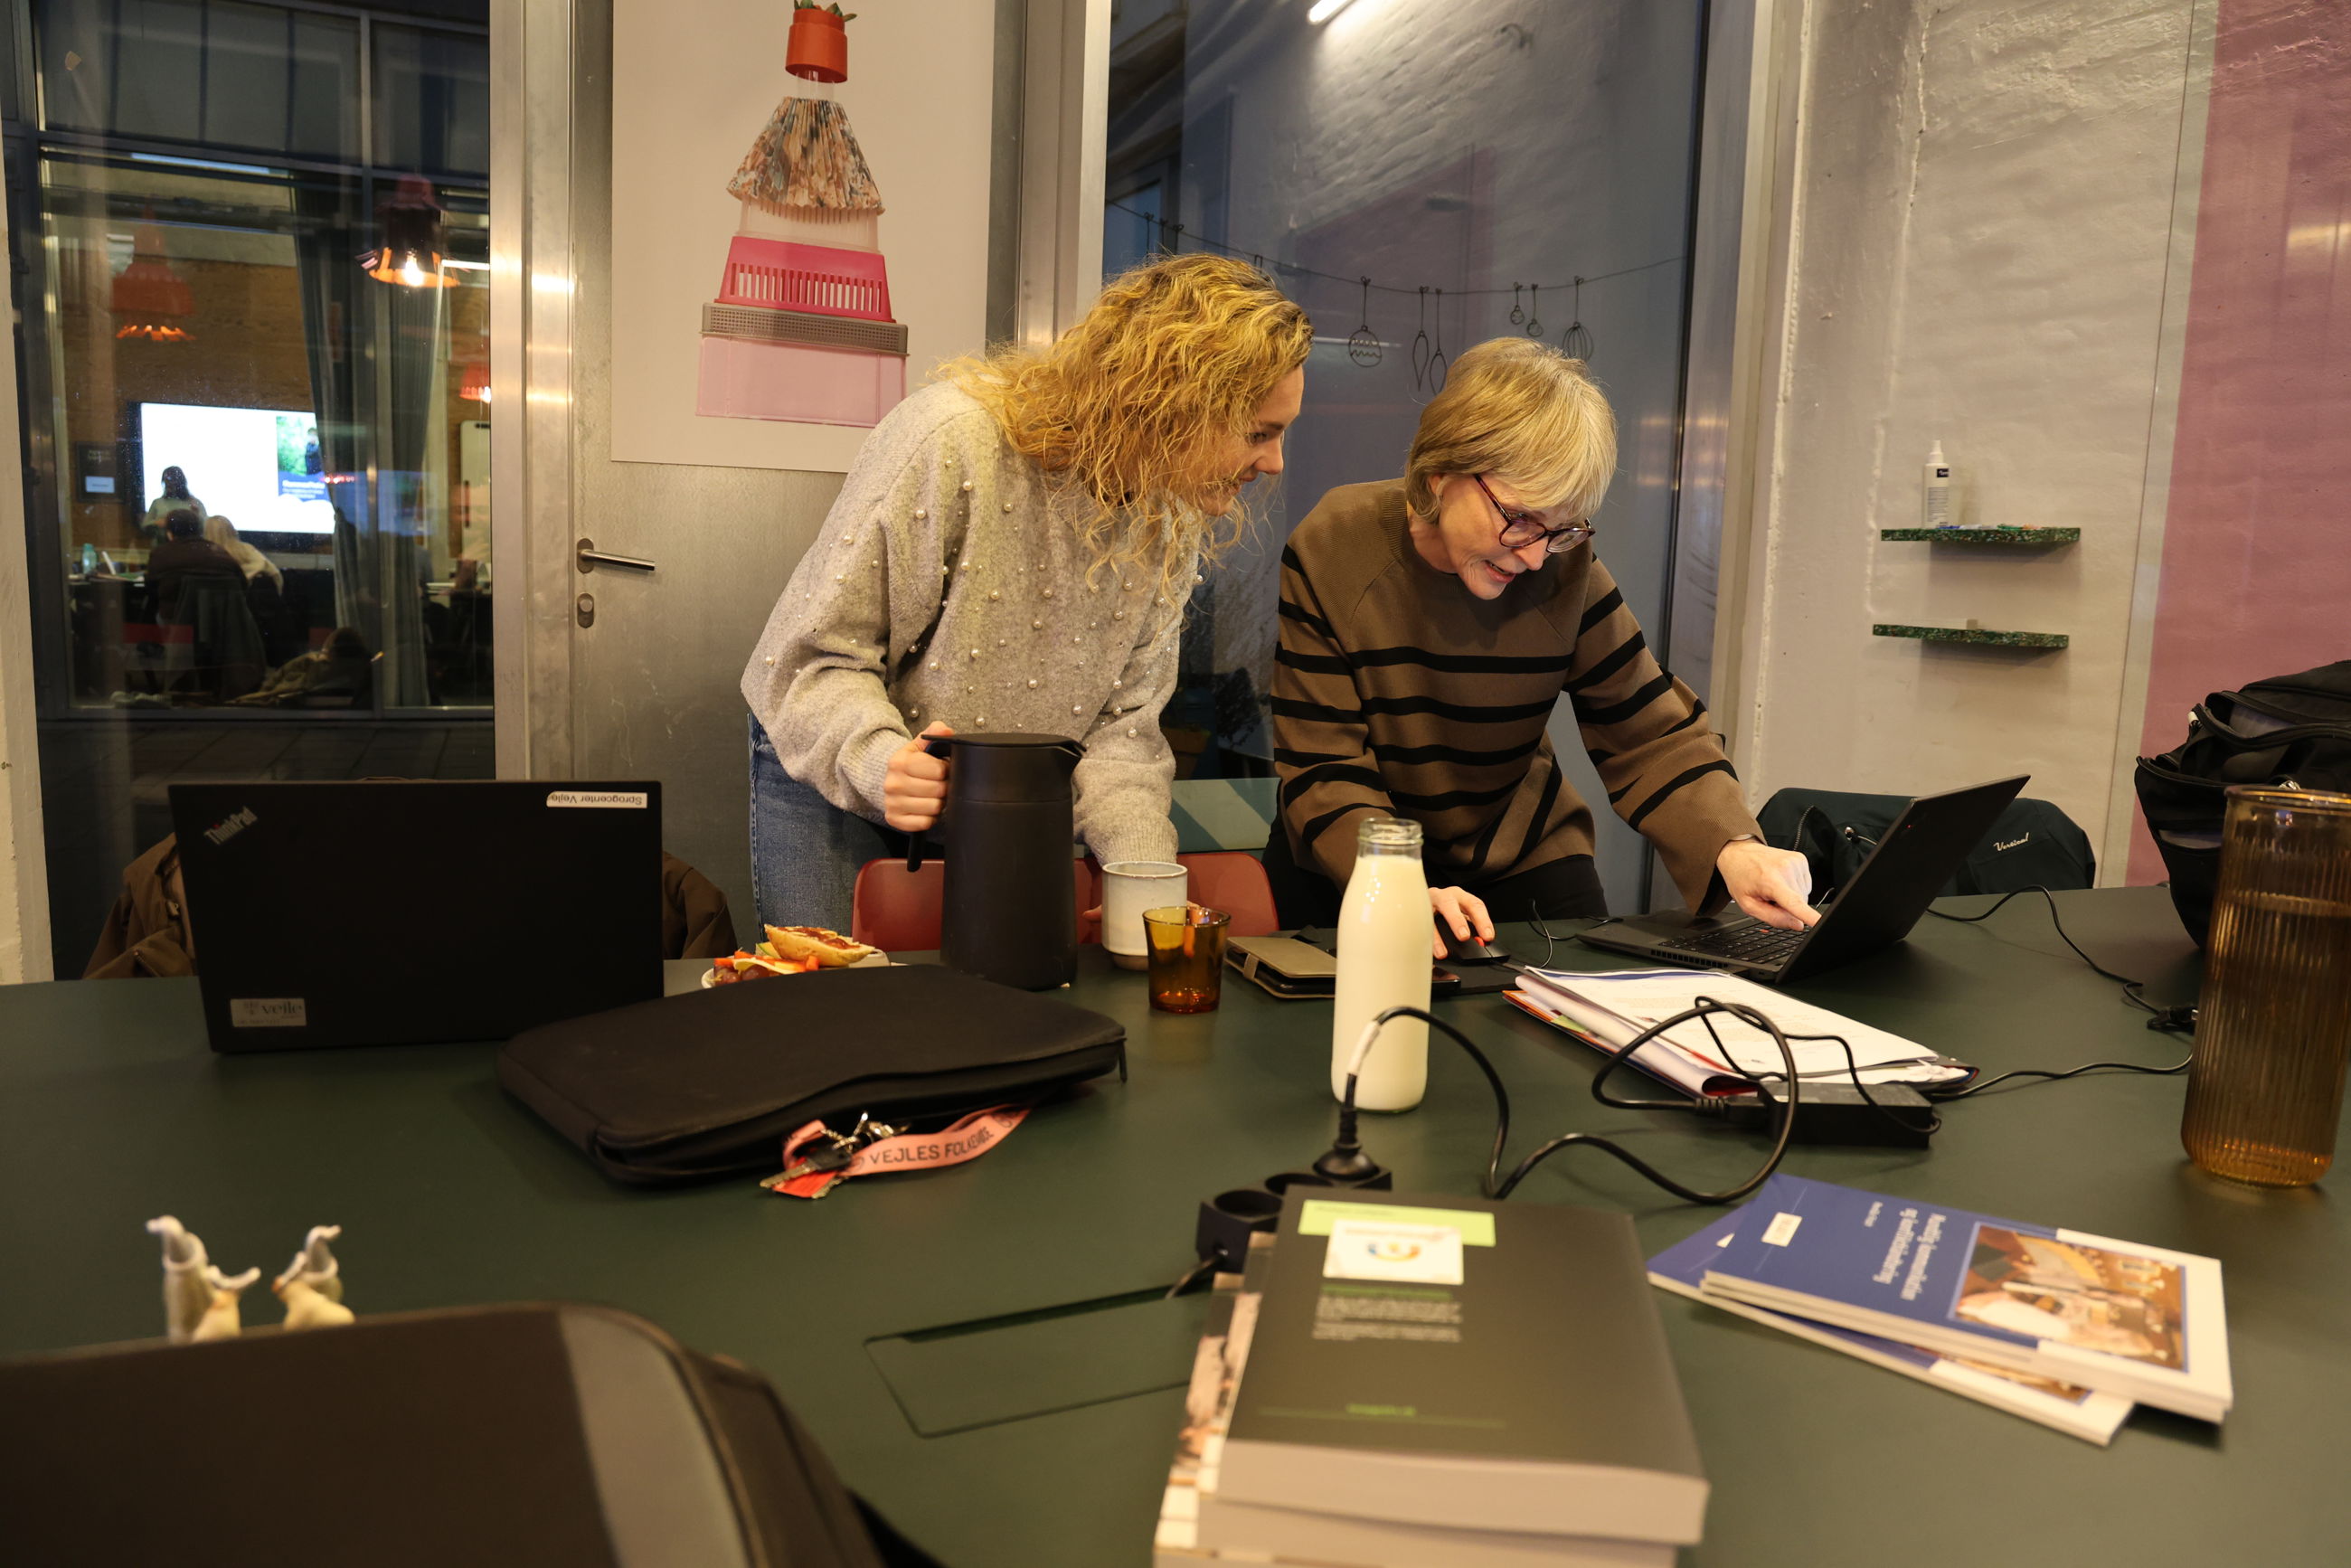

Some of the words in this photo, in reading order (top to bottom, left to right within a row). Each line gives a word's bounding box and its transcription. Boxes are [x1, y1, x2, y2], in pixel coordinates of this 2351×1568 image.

[581, 794, 642, 806] Sprogcenter
[203, 805, 259, 845] ThinkPad
[1993, 832, 2029, 851] Vertical
[870, 1145, 940, 1165] VEJLES
